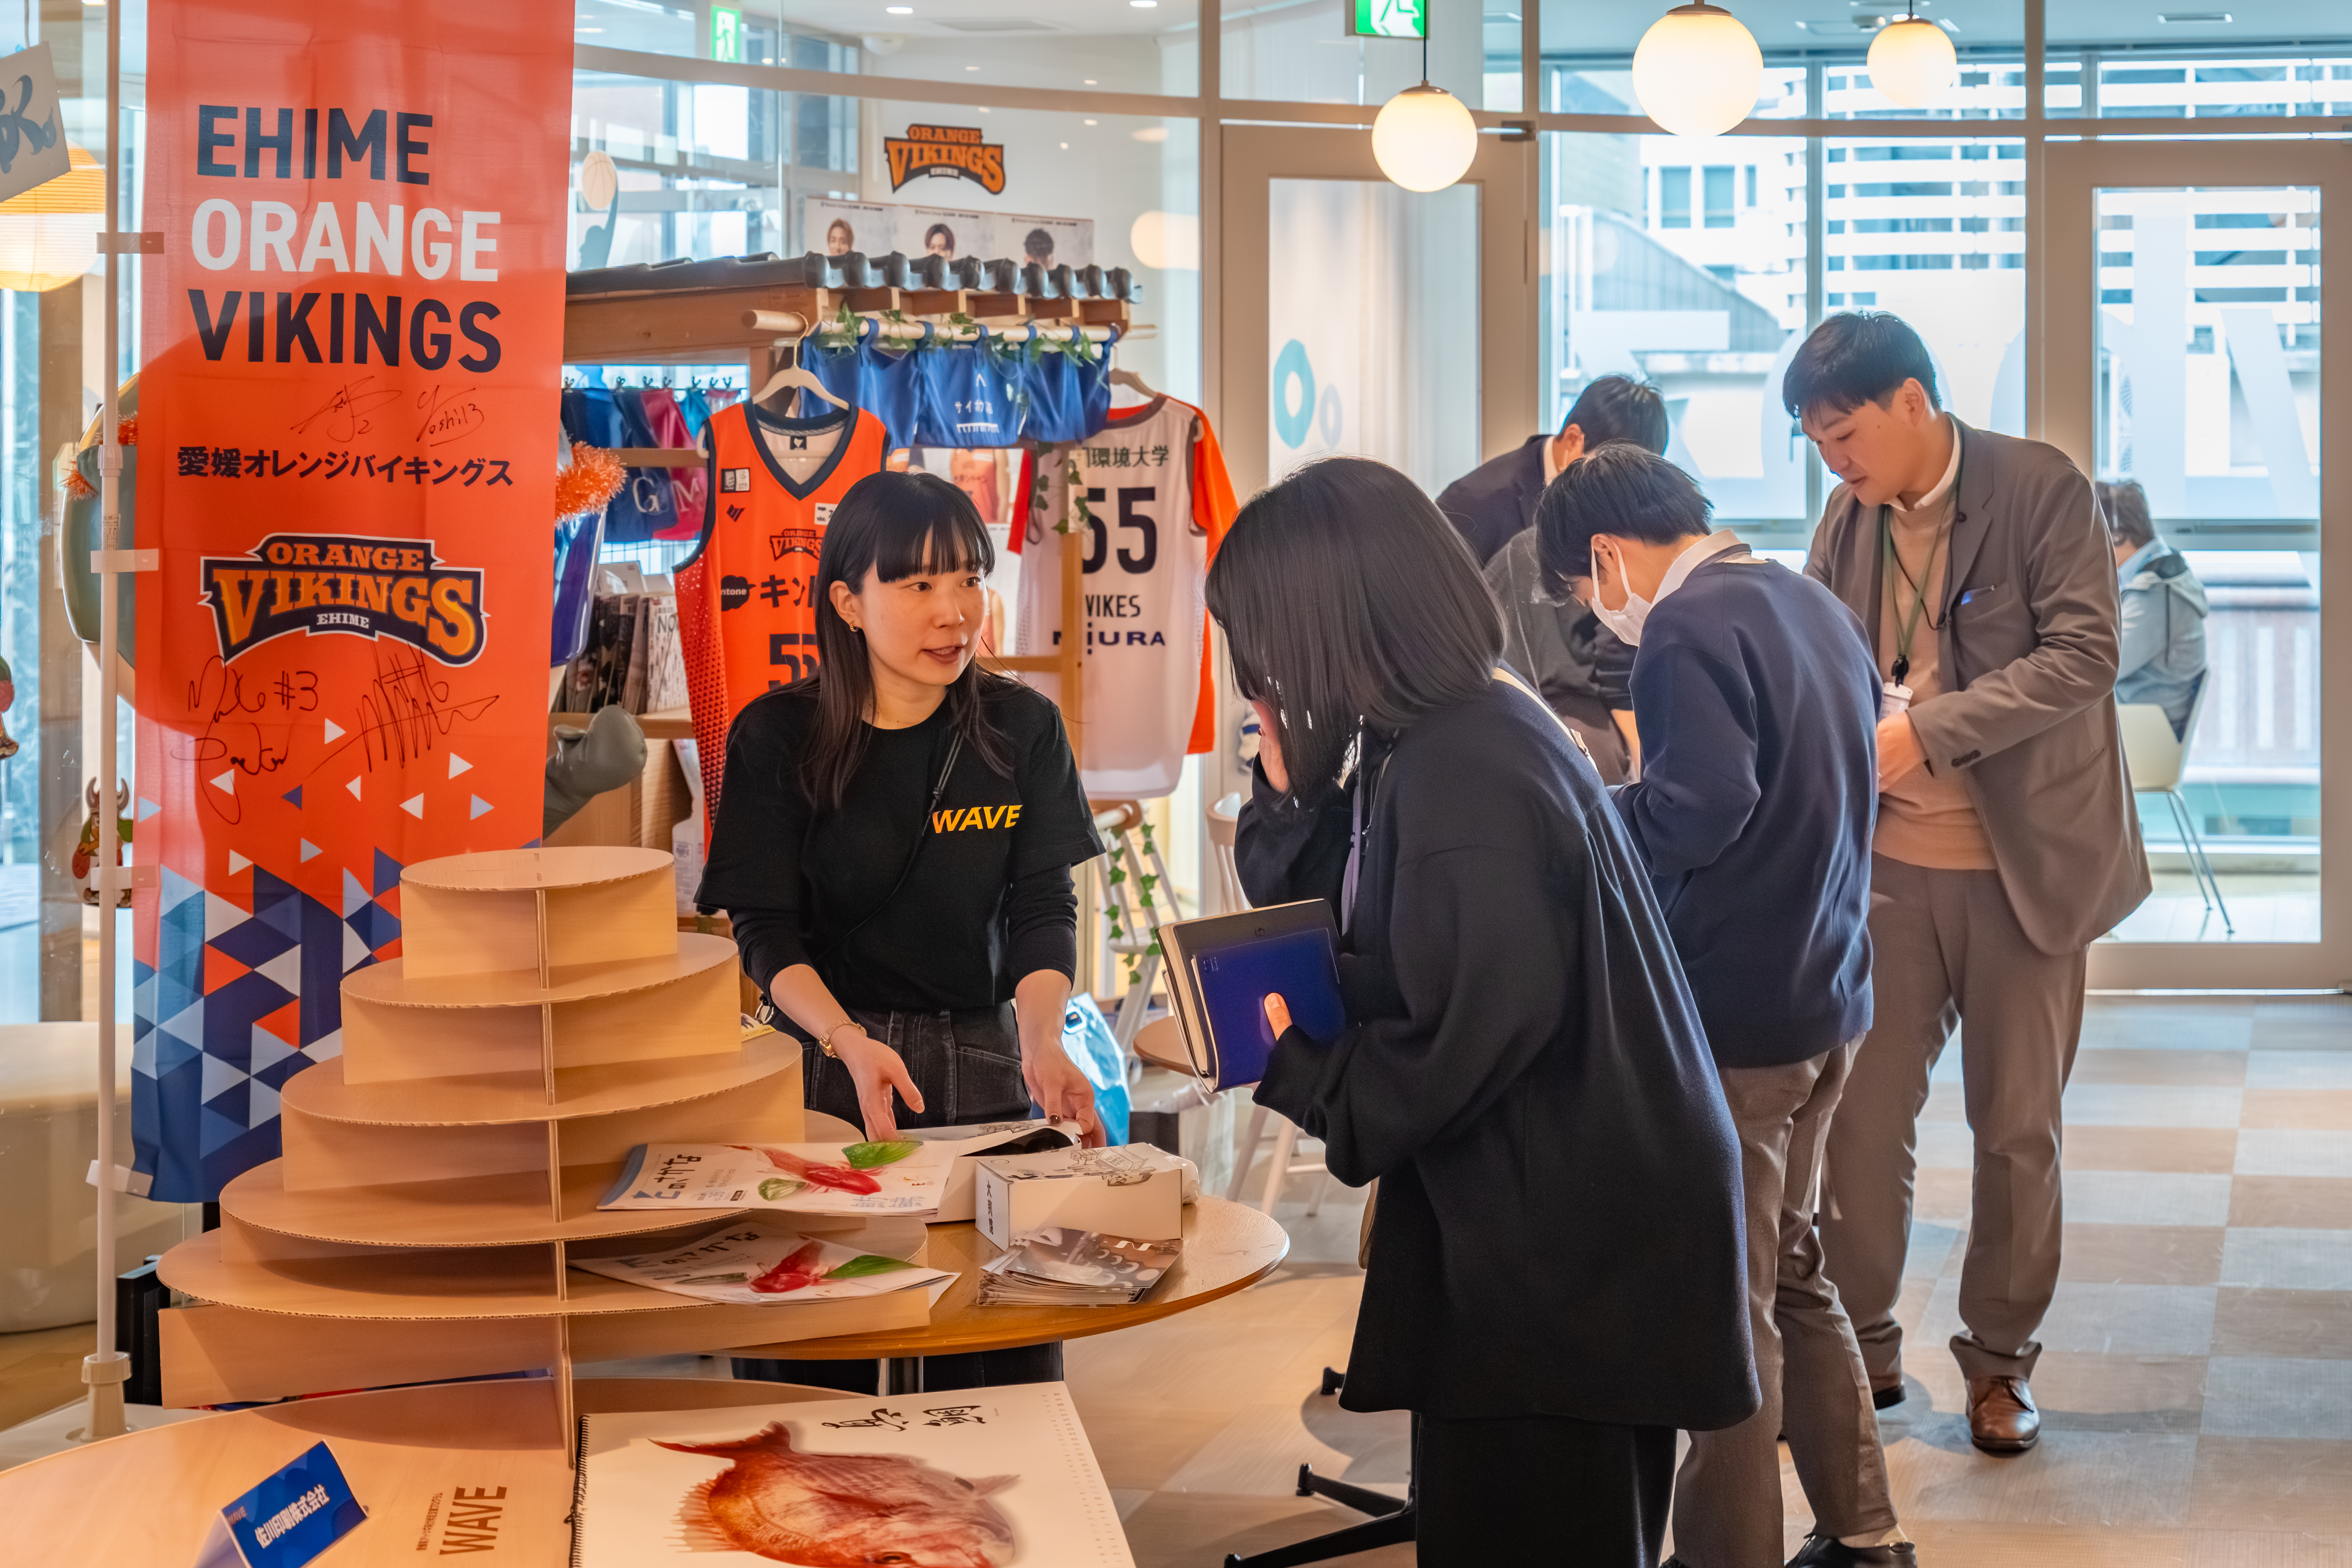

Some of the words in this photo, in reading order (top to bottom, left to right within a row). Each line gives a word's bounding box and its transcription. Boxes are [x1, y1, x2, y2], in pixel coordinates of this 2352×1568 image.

[197, 105, 433, 185] EHIME
[908, 125, 981, 144] ORANGE
[886, 140, 1004, 192] VIKINGS
[191, 198, 501, 281] ORANGE
[188, 289, 501, 372] VIKINGS
[177, 445, 513, 486] 愛媛オレンジバイキングス
[1054, 445, 1169, 468] 環境大学
[267, 542, 424, 571] ORANGE
[212, 568, 474, 655] VIKINGS
[316, 612, 370, 629] EHIME
[1085, 594, 1141, 617] VIKES
[932, 805, 1023, 833] WAVE
[227, 1506, 247, 1526] WAVE
[254, 1484, 331, 1549] 佐川印刷株式会社
[439, 1485, 508, 1555] WAVE
